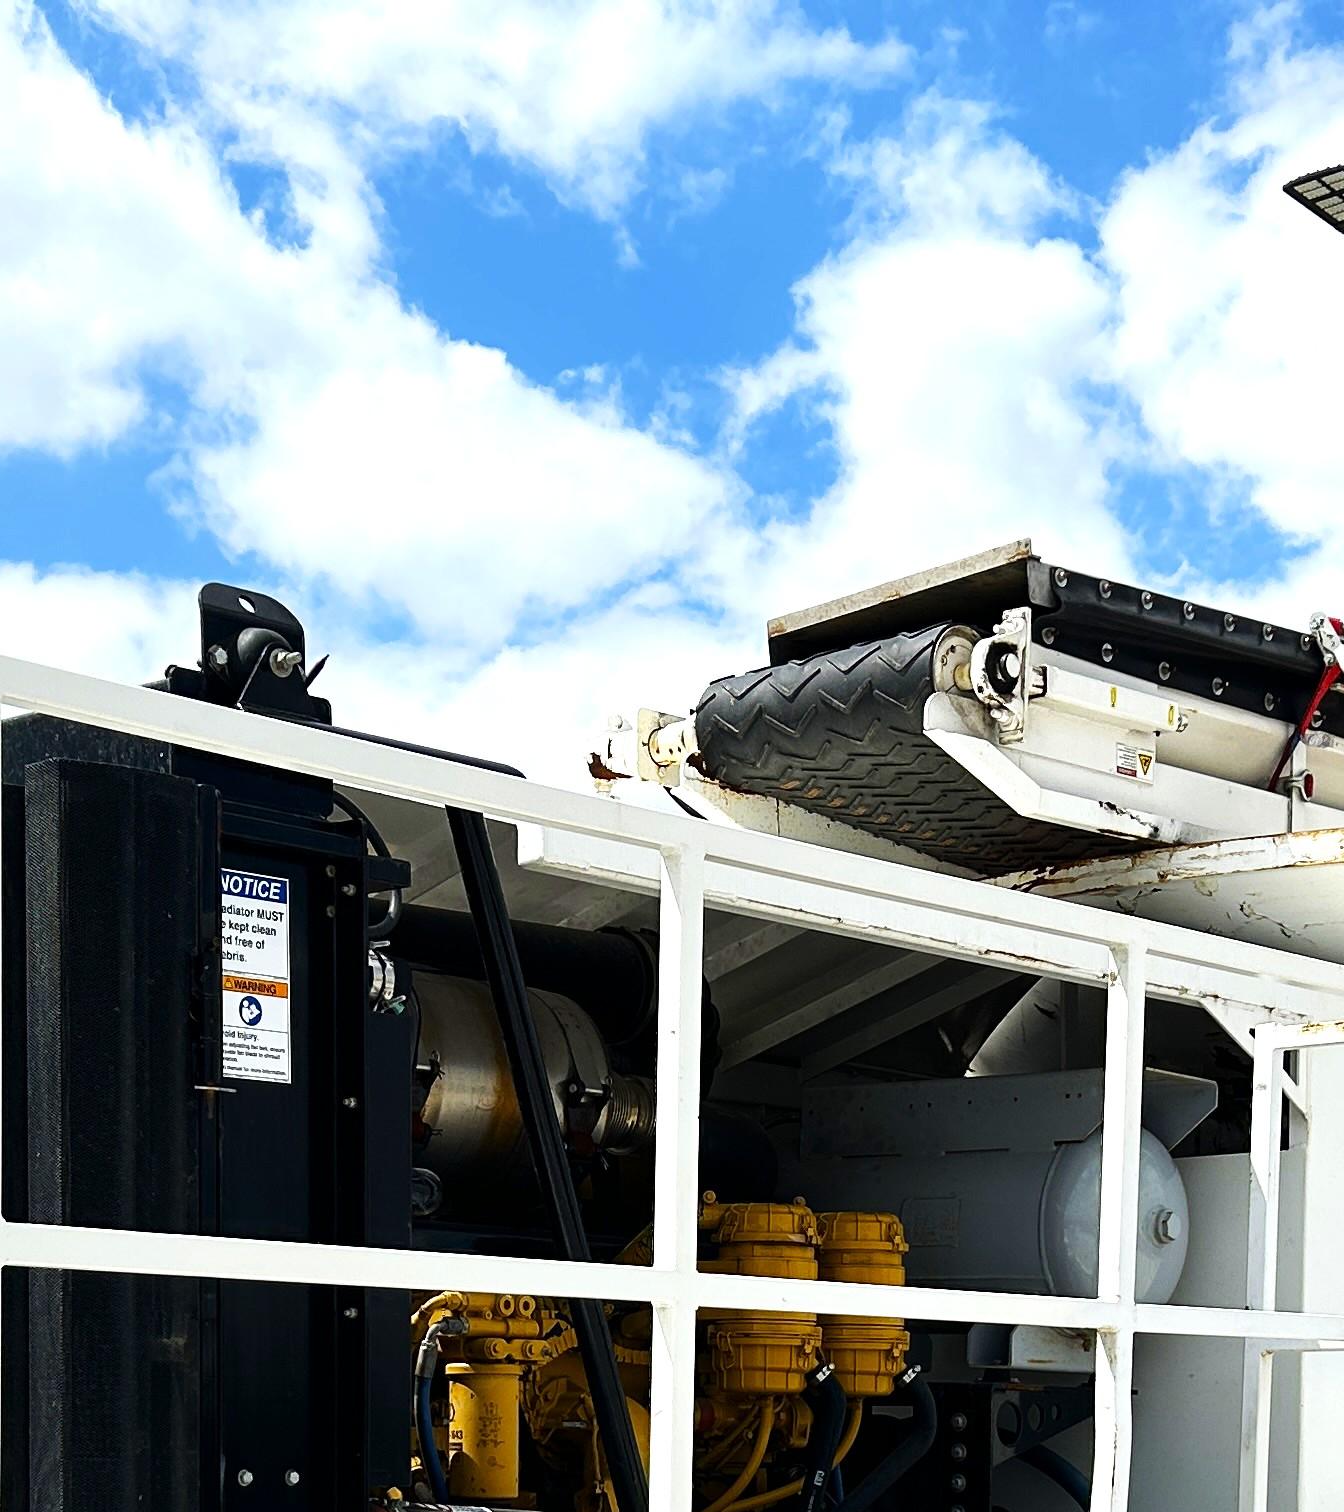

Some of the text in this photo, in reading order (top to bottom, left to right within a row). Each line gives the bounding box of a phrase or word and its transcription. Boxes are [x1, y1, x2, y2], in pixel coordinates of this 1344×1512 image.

[221, 874, 281, 900] NOTICE
[222, 904, 284, 922] adiator MUST
[229, 920, 249, 933] kept
[251, 924, 276, 936] clean
[222, 935, 265, 949] nd free of
[222, 951, 247, 962] ebris.
[234, 979, 277, 994] WARNING
